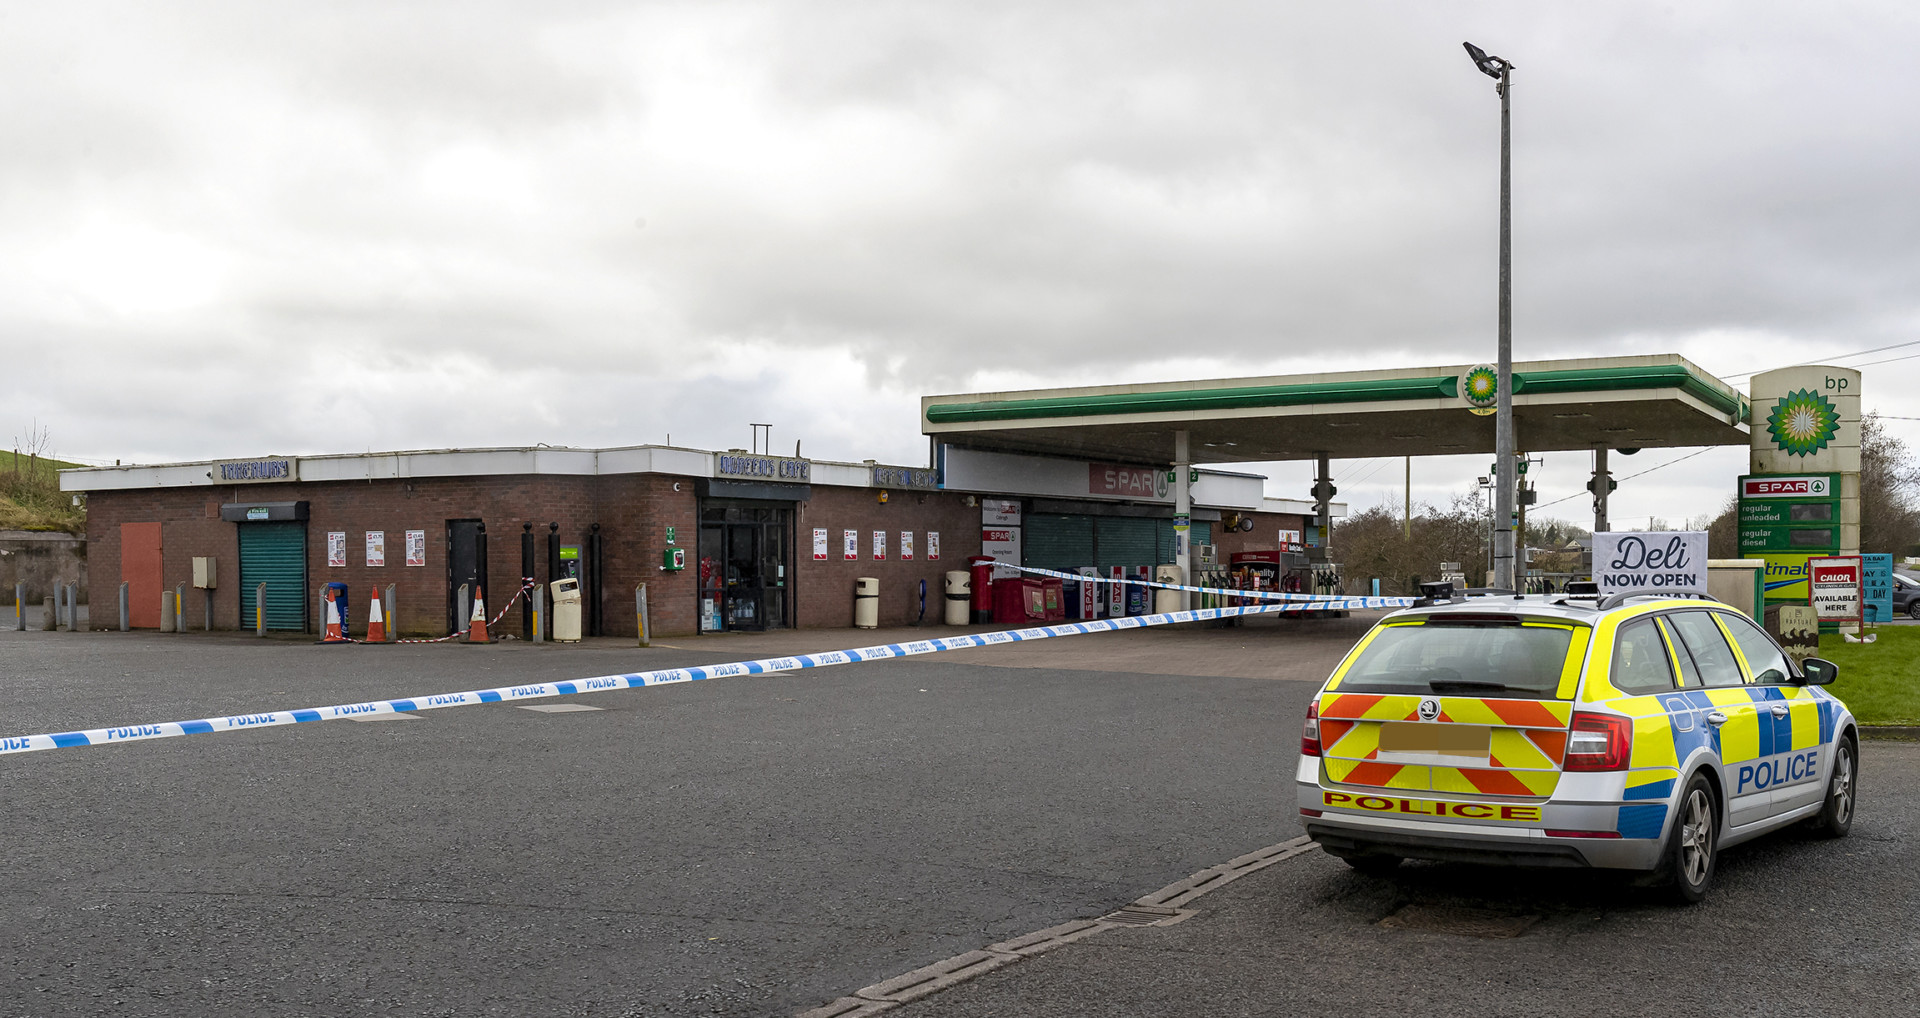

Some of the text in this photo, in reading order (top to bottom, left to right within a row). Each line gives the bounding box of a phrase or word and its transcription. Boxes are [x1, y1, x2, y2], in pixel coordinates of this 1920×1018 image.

[1825, 376, 1848, 393] bp
[220, 460, 289, 480] TAKEAWAY
[720, 455, 808, 478] NOREENS CAFE
[1520, 464, 1525, 472] 4
[1104, 470, 1153, 492] SPAR
[1758, 482, 1808, 492] SPAR
[1742, 504, 1772, 513] regular
[990, 532, 1009, 540] SPAR
[1742, 529, 1772, 538] regular
[1611, 536, 1690, 570] Deli
[1765, 562, 1808, 576] timat
[1260, 578, 1270, 586] oal
[1604, 574, 1696, 586] NOW OPEN
[1820, 574, 1850, 583] CALOR
[1873, 589, 1886, 598] DAY
[108, 725, 162, 740] POLICE
[228, 714, 276, 727] POLICE
[334, 703, 377, 716] POLICE
[427, 694, 466, 706] POLICE
[511, 686, 546, 697] POLICE
[586, 678, 617, 690] POLICE
[653, 671, 682, 682] POLICE
[714, 664, 740, 676] POLICE
[768, 658, 794, 670] POLICE
[819, 653, 842, 664] POLICE
[865, 648, 888, 659] POLICE
[908, 642, 929, 653] POLICE
[949, 638, 969, 646] POLICE
[987, 633, 1006, 643] POLICE
[1023, 629, 1041, 638] POLICE
[1056, 626, 1074, 634] POLICE
[1089, 622, 1106, 630] POLICE
[1119, 618, 1135, 627] POLICE
[1149, 616, 1163, 624] POLICE
[1176, 612, 1189, 620] POLICE
[1201, 610, 1213, 618] POLICE
[1737, 751, 1818, 794] POLICE
[1324, 792, 1539, 821] POLICE
